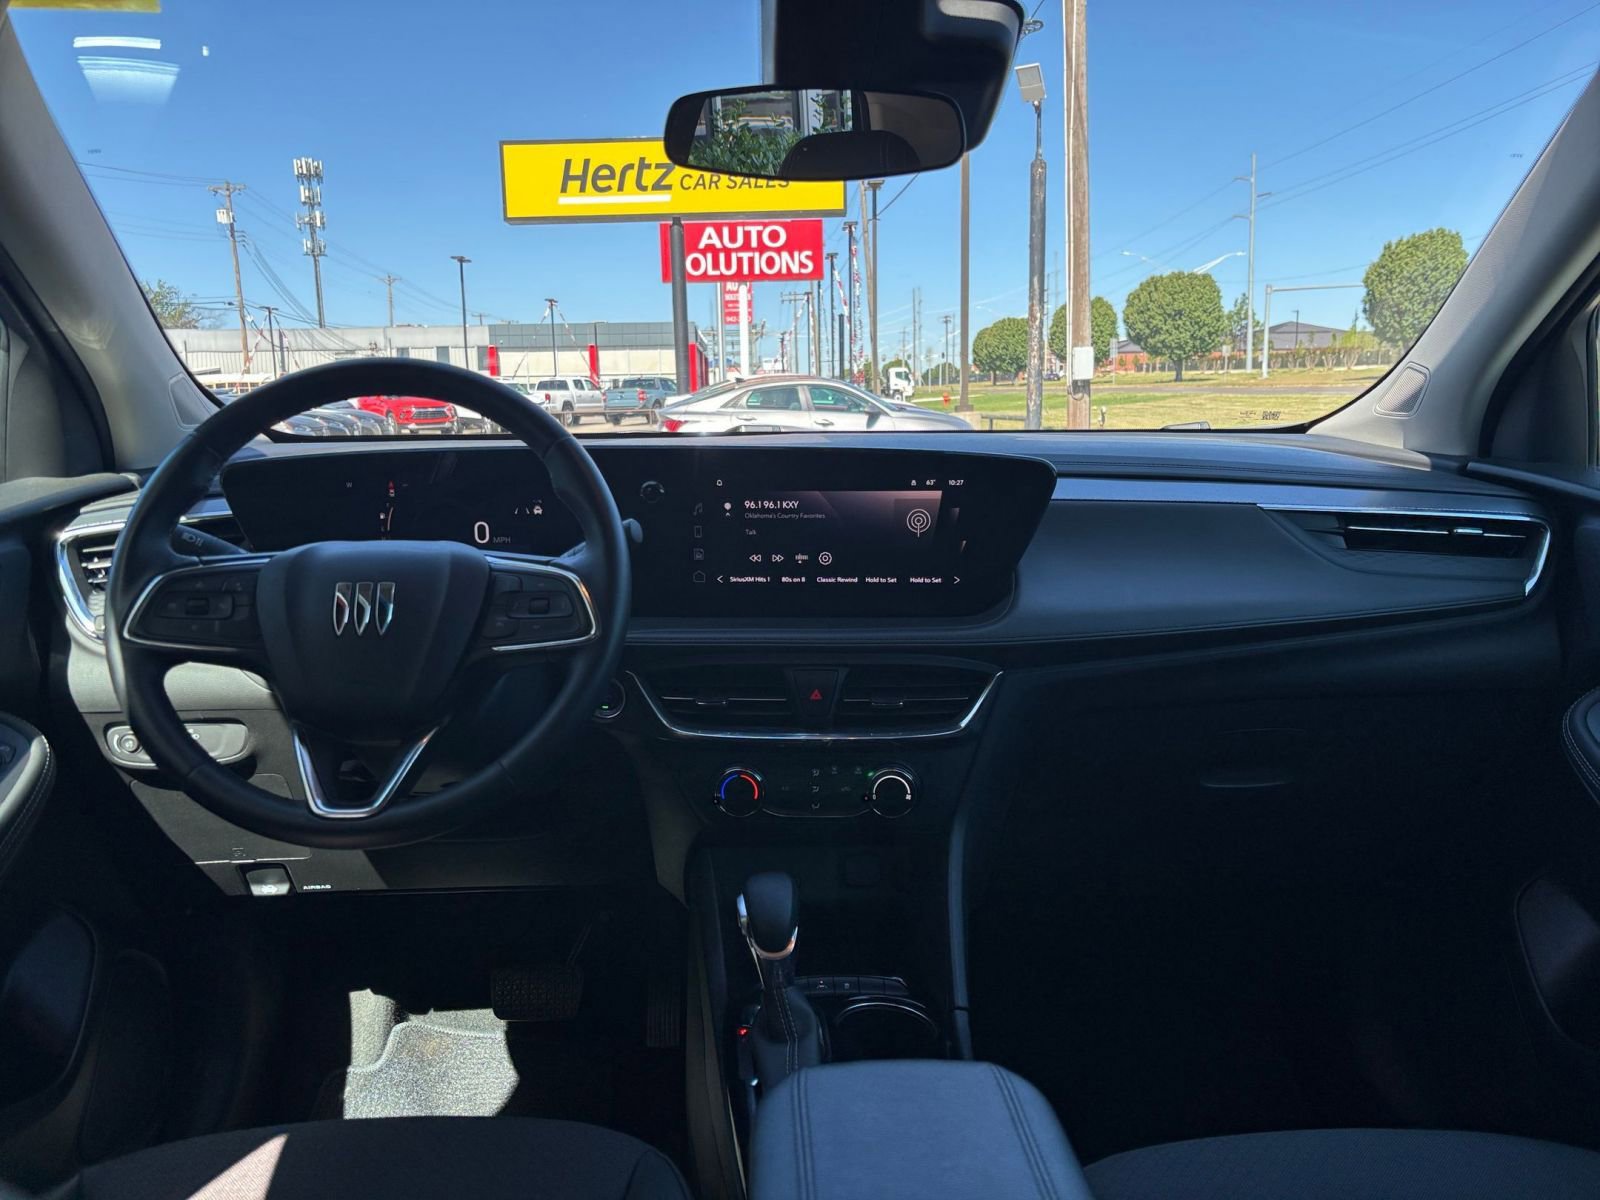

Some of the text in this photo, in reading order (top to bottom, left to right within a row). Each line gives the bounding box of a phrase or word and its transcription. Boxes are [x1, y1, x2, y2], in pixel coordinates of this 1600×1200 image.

[560, 157, 676, 193] Hertz
[680, 173, 721, 190] CAR
[698, 225, 787, 249] AUTO
[685, 251, 814, 276] OLUTIONS
[744, 500, 799, 509] 96.1 96.1 KXY
[777, 512, 799, 520] Country
[474, 521, 490, 544] 0
